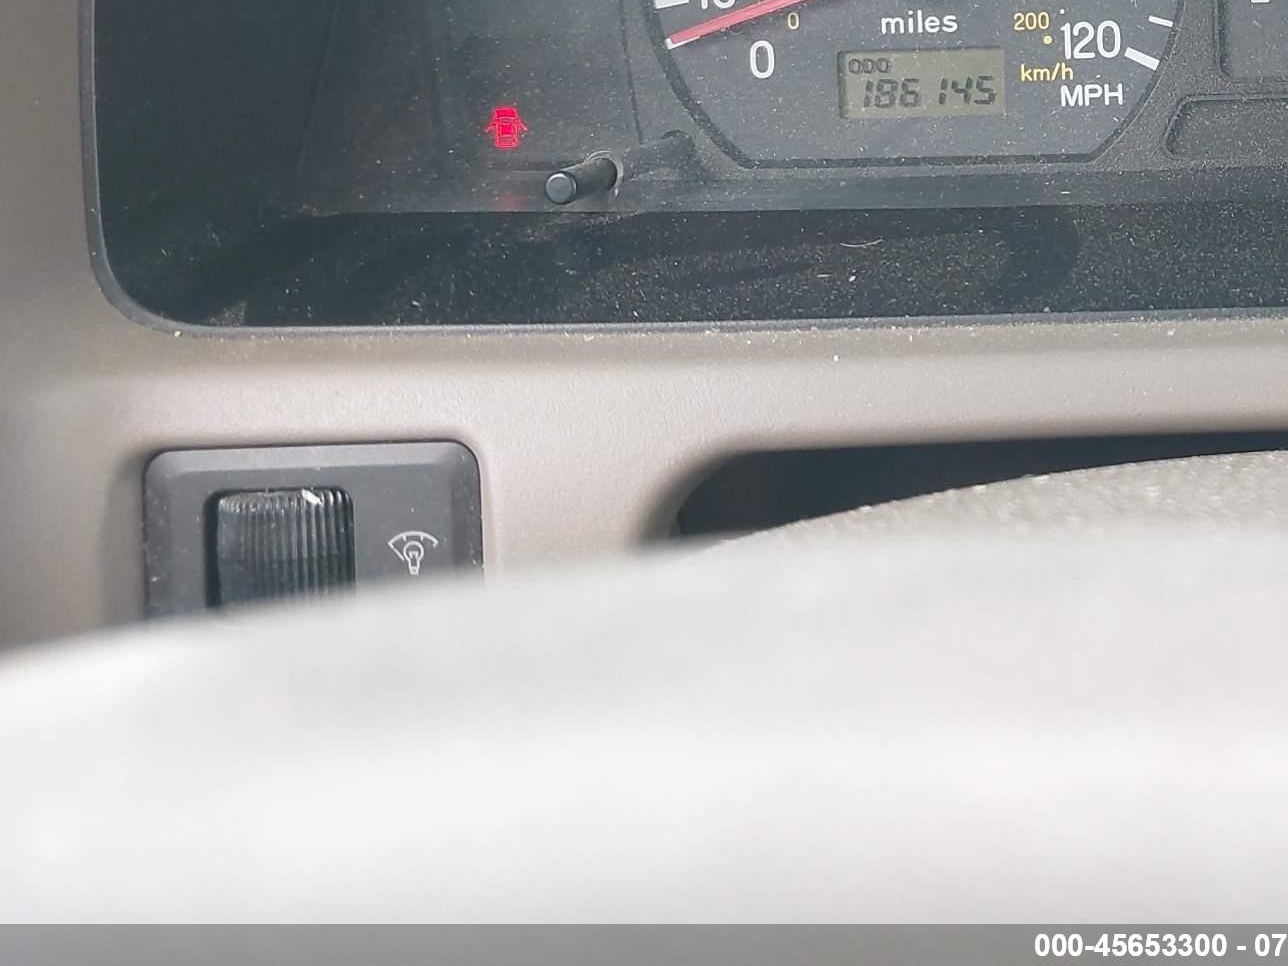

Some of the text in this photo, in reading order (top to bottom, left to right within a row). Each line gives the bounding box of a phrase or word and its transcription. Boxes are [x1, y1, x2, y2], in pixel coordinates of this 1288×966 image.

[787, 12, 800, 30] 0
[881, 10, 958, 34] miles
[1013, 13, 1049, 30] 200
[1061, 21, 1121, 59] 120
[749, 41, 774, 78] 0
[848, 58, 891, 74] ODO
[1020, 62, 1074, 82] km/h
[1060, 84, 1123, 106] MPH
